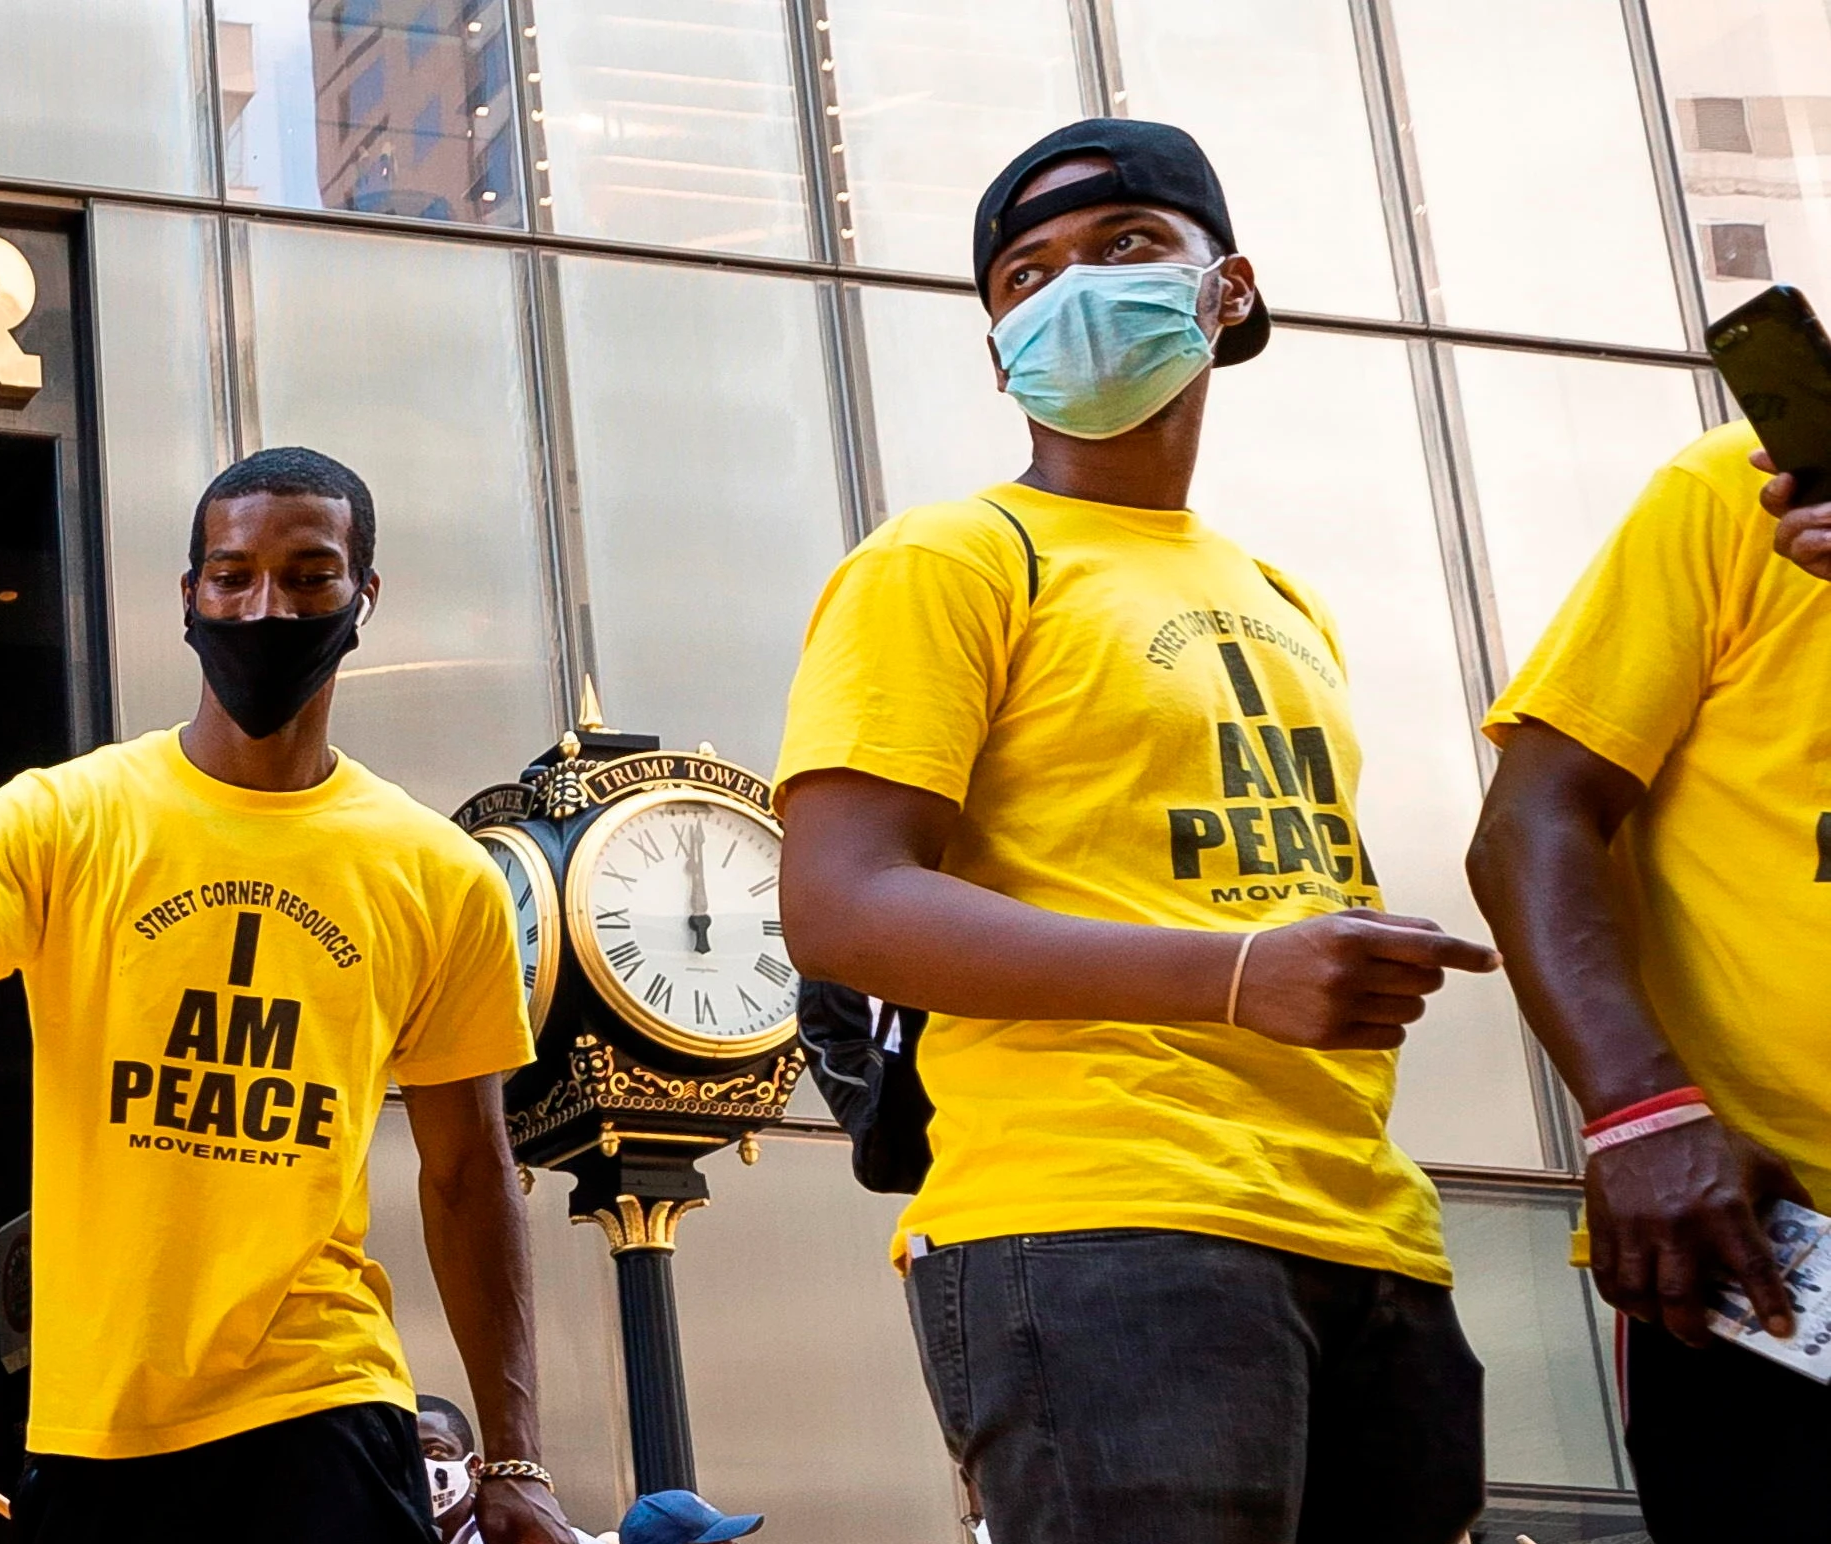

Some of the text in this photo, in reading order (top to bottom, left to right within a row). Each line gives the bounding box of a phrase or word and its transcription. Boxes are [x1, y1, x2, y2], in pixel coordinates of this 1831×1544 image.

[1146, 620, 1187, 670] STREET
[1239, 615, 1337, 690] RESOURCES
[1217, 641, 1269, 718] I
[595, 760, 765, 806] TRUMP TOWER
[1217, 722, 1338, 805] AM
[134, 880, 362, 969] STREET CORNER RESOURCES
[1211, 881, 1372, 909] MOVEMENT
[227, 911, 263, 988] I
[163, 988, 302, 1071] AM
[110, 1060, 338, 1150] PEACE
[129, 1134, 302, 1168] MOVEMENT
